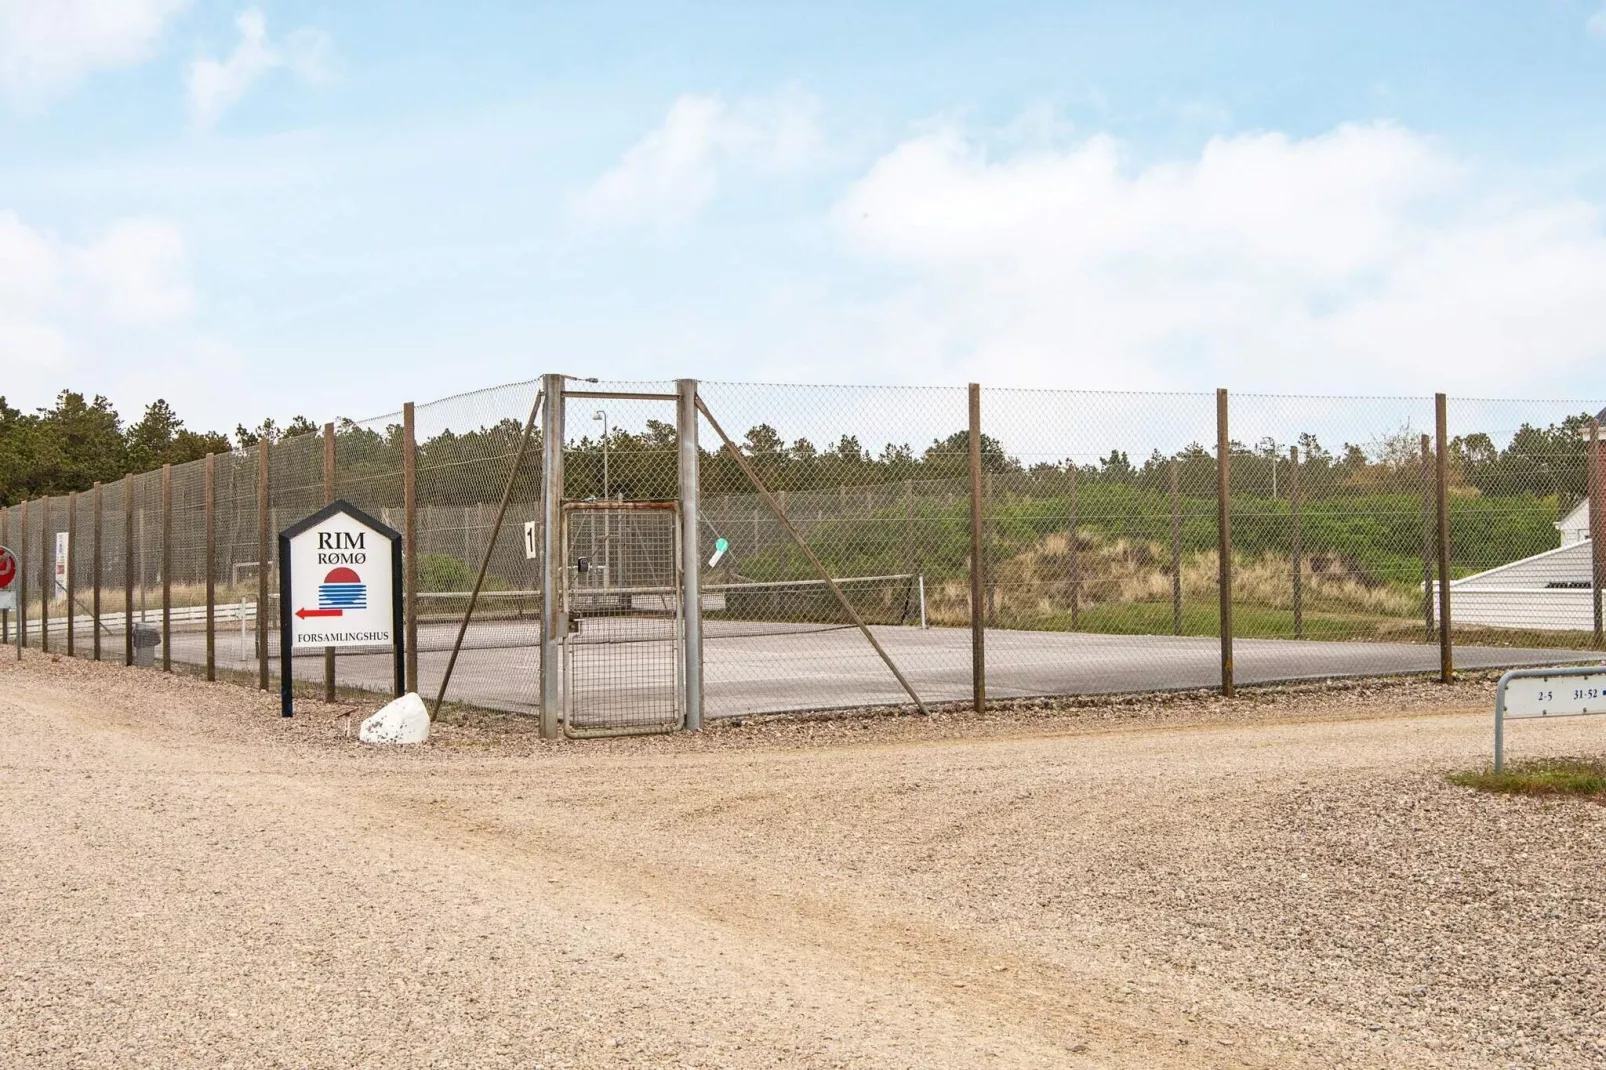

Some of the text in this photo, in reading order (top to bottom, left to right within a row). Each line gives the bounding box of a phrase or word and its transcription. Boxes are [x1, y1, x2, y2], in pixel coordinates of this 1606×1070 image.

[317, 531, 366, 550] RIM
[527, 527, 534, 552] 1
[317, 552, 366, 565] RØMØ
[297, 631, 389, 643] FORSAMLINGSHUS
[1538, 688, 1598, 701] 2-5 31-52
